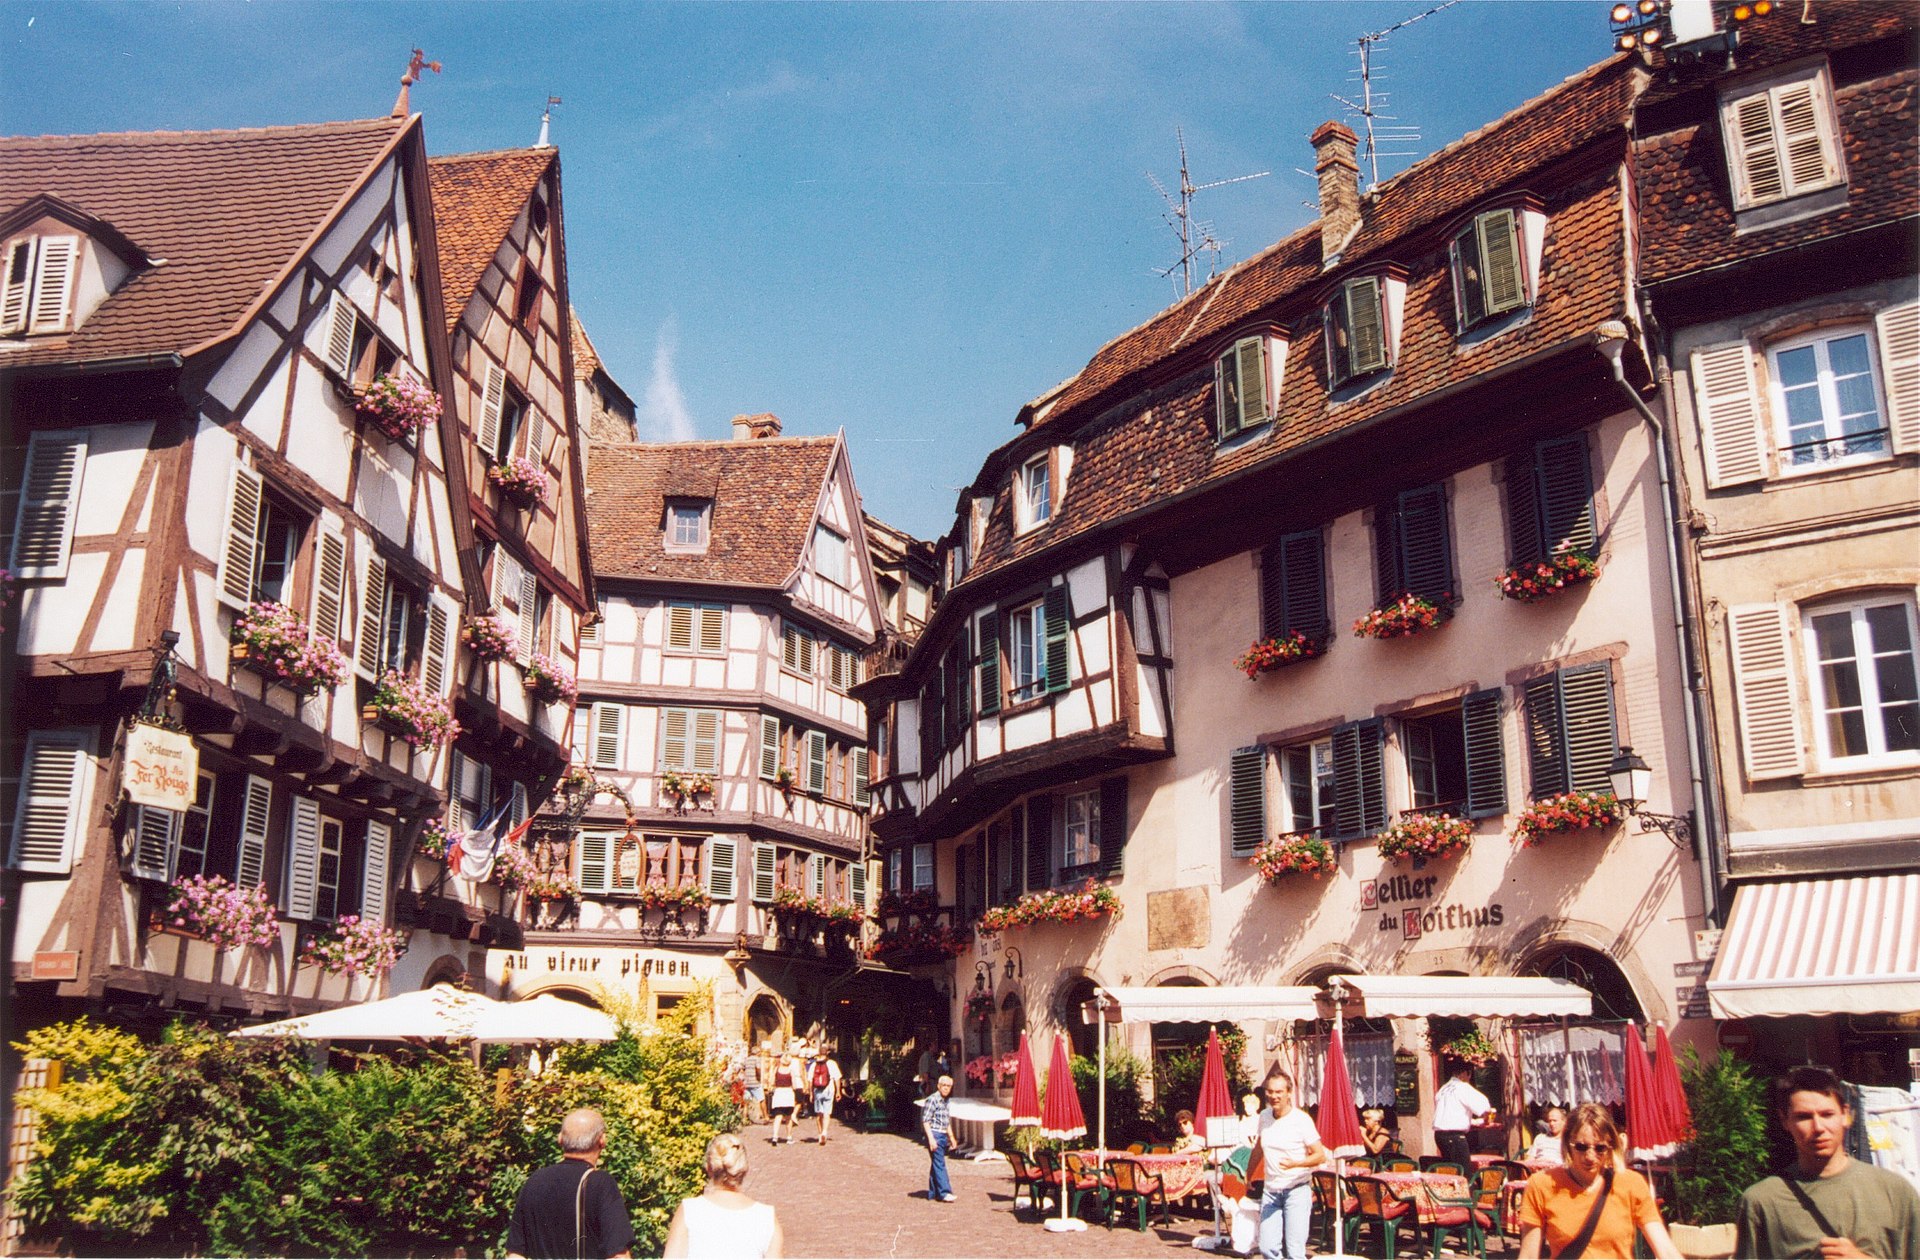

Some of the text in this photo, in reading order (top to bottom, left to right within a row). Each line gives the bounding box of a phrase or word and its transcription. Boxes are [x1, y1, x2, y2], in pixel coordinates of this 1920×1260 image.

[130, 759, 189, 796] Fer Rouge
[1361, 874, 1438, 909] Cellier
[1379, 912, 1398, 932] du
[505, 951, 690, 978] au vieux pignon
